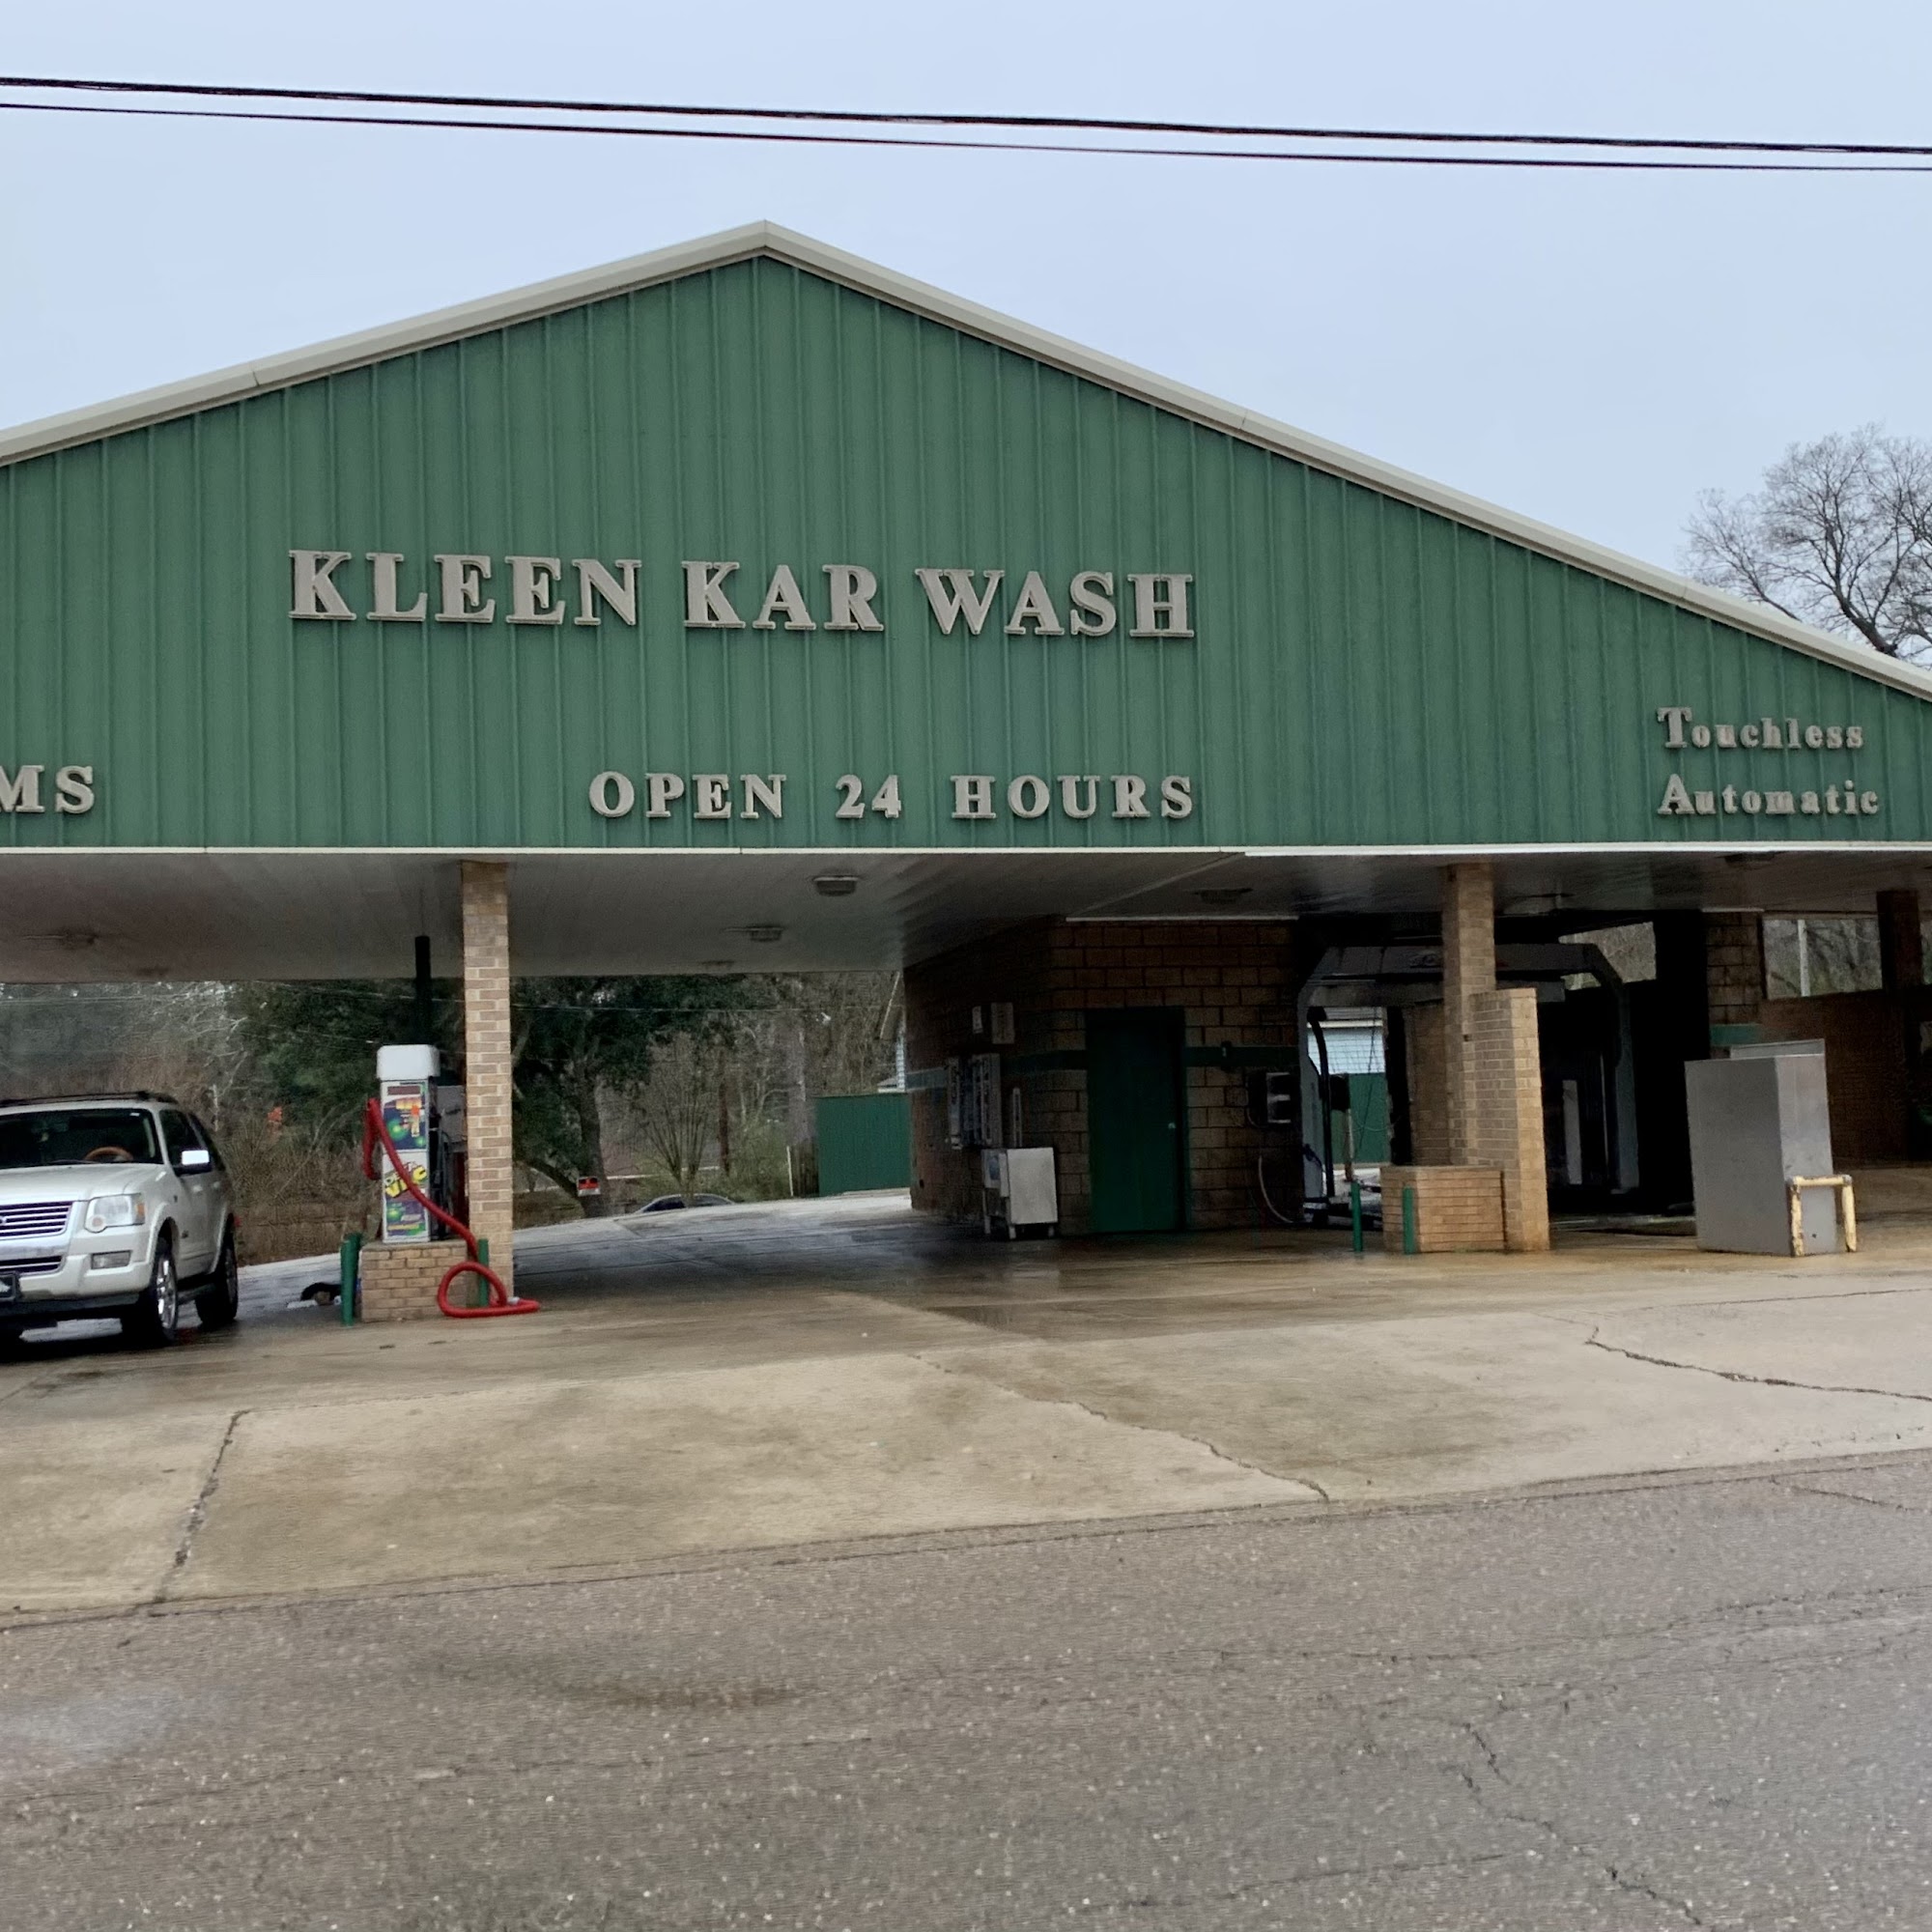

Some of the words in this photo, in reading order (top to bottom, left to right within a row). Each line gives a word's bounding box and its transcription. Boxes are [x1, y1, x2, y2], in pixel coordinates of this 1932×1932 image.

[289, 550, 641, 626] KLEEN
[682, 561, 884, 632] KAR
[915, 568, 1194, 639] WASH
[1657, 707, 1863, 749] Touchless
[588, 771, 785, 819] OPEN
[835, 775, 902, 818] 24
[951, 775, 1193, 819] HOURS
[1657, 773, 1880, 815] Automatic
